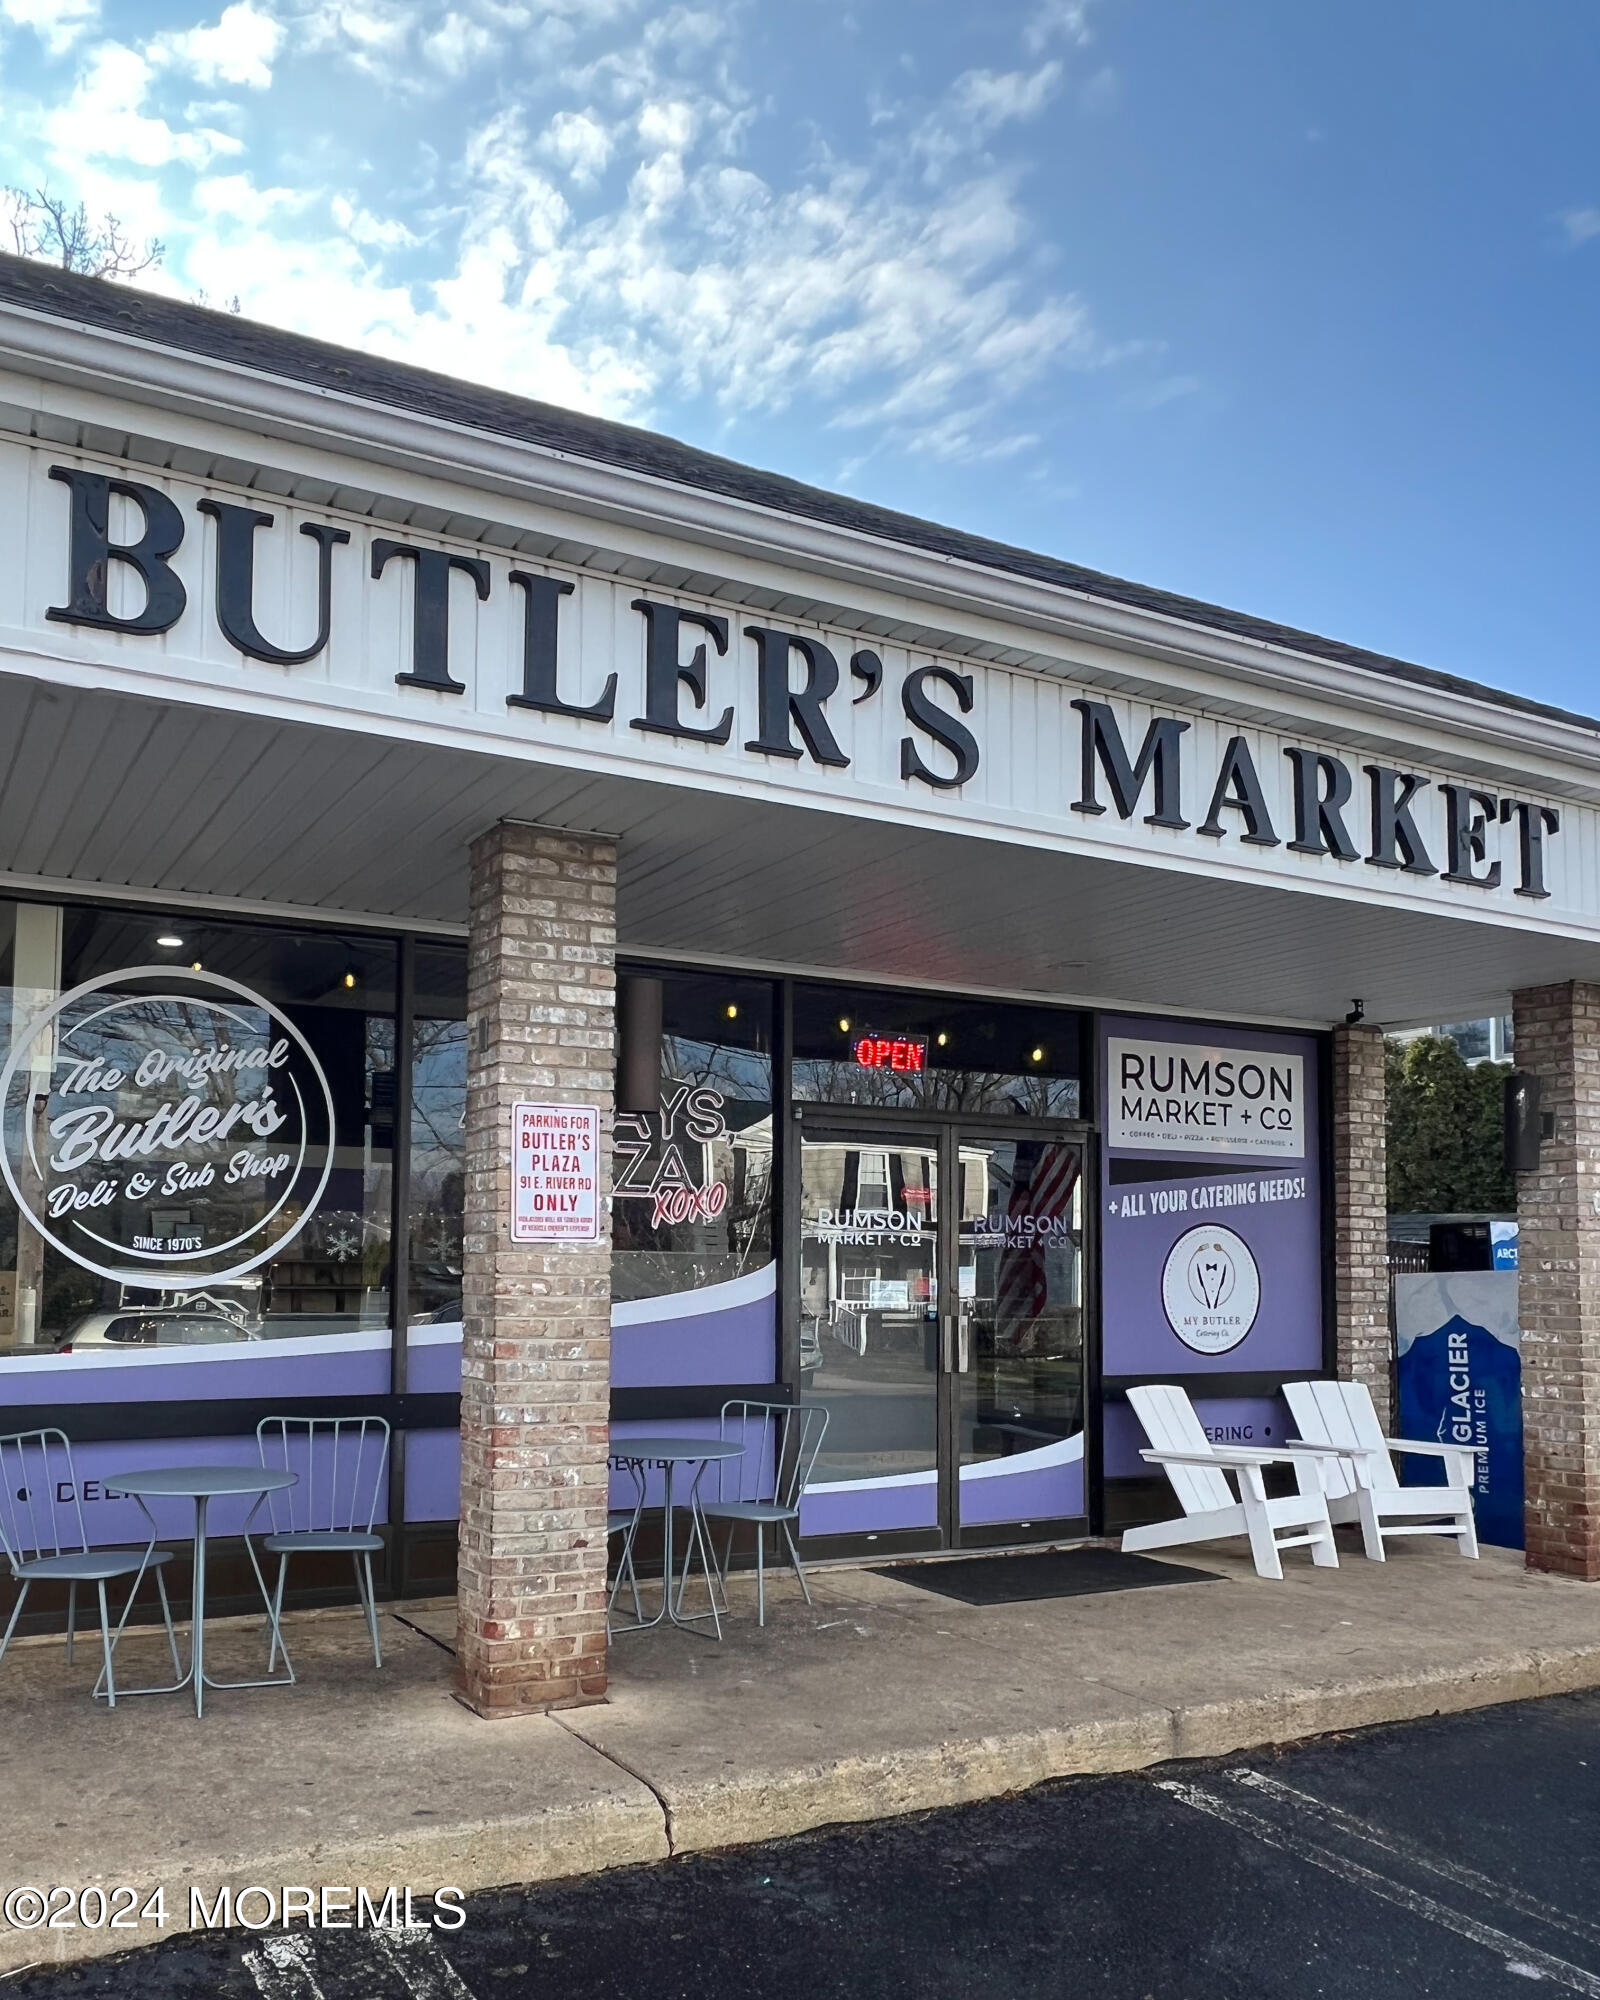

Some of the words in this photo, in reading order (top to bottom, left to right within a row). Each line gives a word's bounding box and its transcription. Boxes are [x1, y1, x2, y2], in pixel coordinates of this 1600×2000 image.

[45, 465, 980, 789] BUTLER'S
[1070, 699, 1560, 899] MARKET
[53, 1054, 126, 1097] The
[134, 1038, 289, 1089] Original
[857, 1040, 923, 1071] OPEN
[1121, 1053, 1293, 1103] RUMSON
[522, 1114, 568, 1129] PARKING
[570, 1116, 590, 1129] FOR
[1121, 1096, 1233, 1127] MARKET
[1240, 1109, 1252, 1124] +
[50, 1085, 287, 1172] Butler's
[522, 1132, 590, 1151] BUTLER'S
[532, 1154, 581, 1172] PLAZA
[48, 1180, 118, 1218] Deli
[124, 1172, 157, 1199] &
[161, 1162, 216, 1196] Sub
[224, 1150, 290, 1184] Shop
[520, 1176, 531, 1189] 91
[534, 1176, 543, 1189] E.
[545, 1177, 576, 1190] RIVER
[578, 1177, 592, 1190] RD
[533, 1194, 578, 1212] ONLY
[651, 1181, 728, 1230] XOXO
[1121, 1194, 1146, 1218] ALL
[1150, 1190, 1188, 1214] YOUR
[1191, 1182, 1256, 1210] CATERING
[1260, 1177, 1306, 1202] NEEDS!
[818, 1208, 922, 1231] RUMSON
[974, 1213, 1068, 1236] RUMSON
[133, 1235, 164, 1251] SINCE
[817, 1232, 885, 1246] MARKET
[1183, 1315, 1199, 1326] MY
[1202, 1315, 1241, 1326] BUTLER
[1448, 1333, 1472, 1442] GLACIER
[1474, 1389, 1487, 1414] ICE
[1475, 1421, 1490, 1494] PREMUM
